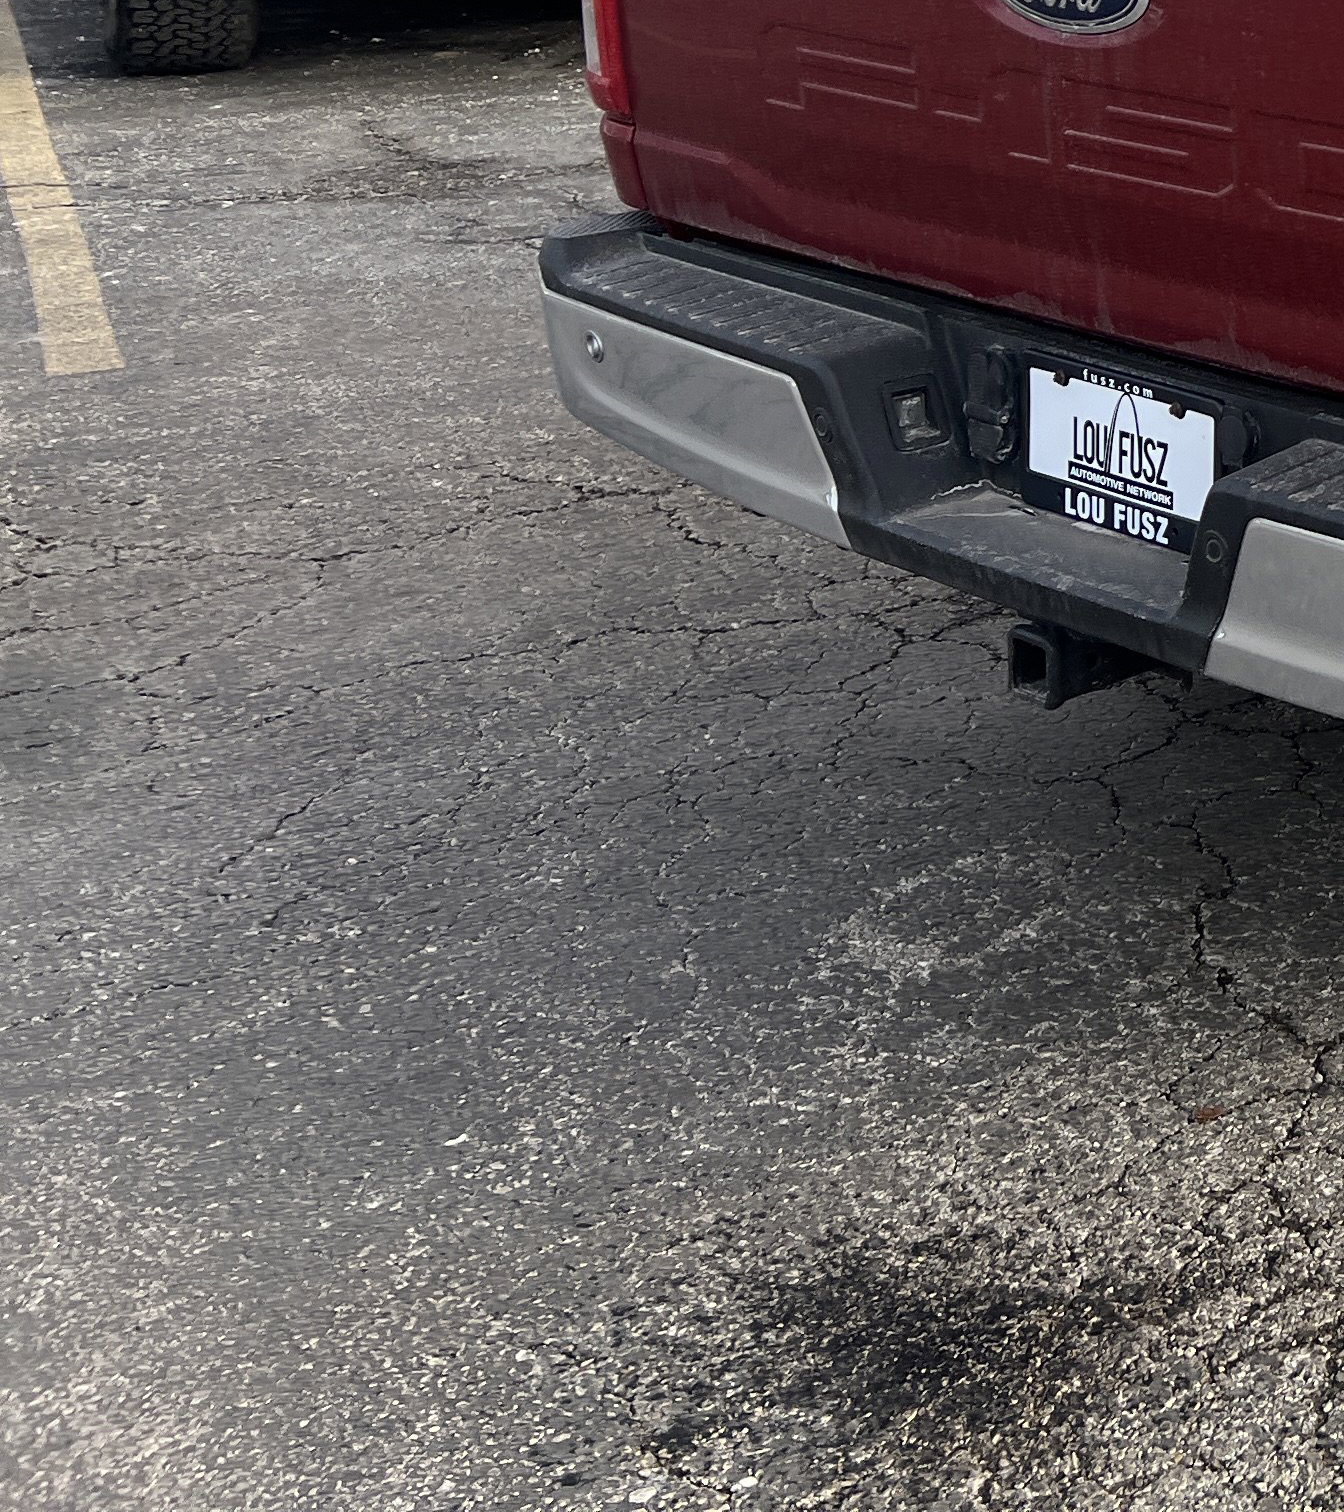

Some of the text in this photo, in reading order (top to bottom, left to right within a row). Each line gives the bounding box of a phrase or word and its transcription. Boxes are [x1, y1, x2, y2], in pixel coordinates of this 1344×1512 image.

[1082, 368, 1154, 399] fusz.com
[1073, 416, 1169, 488] LOU FUSZ
[1070, 467, 1171, 506] AUTOMOTIVE NETWORK
[1064, 487, 1169, 545] LOU FUSZ
